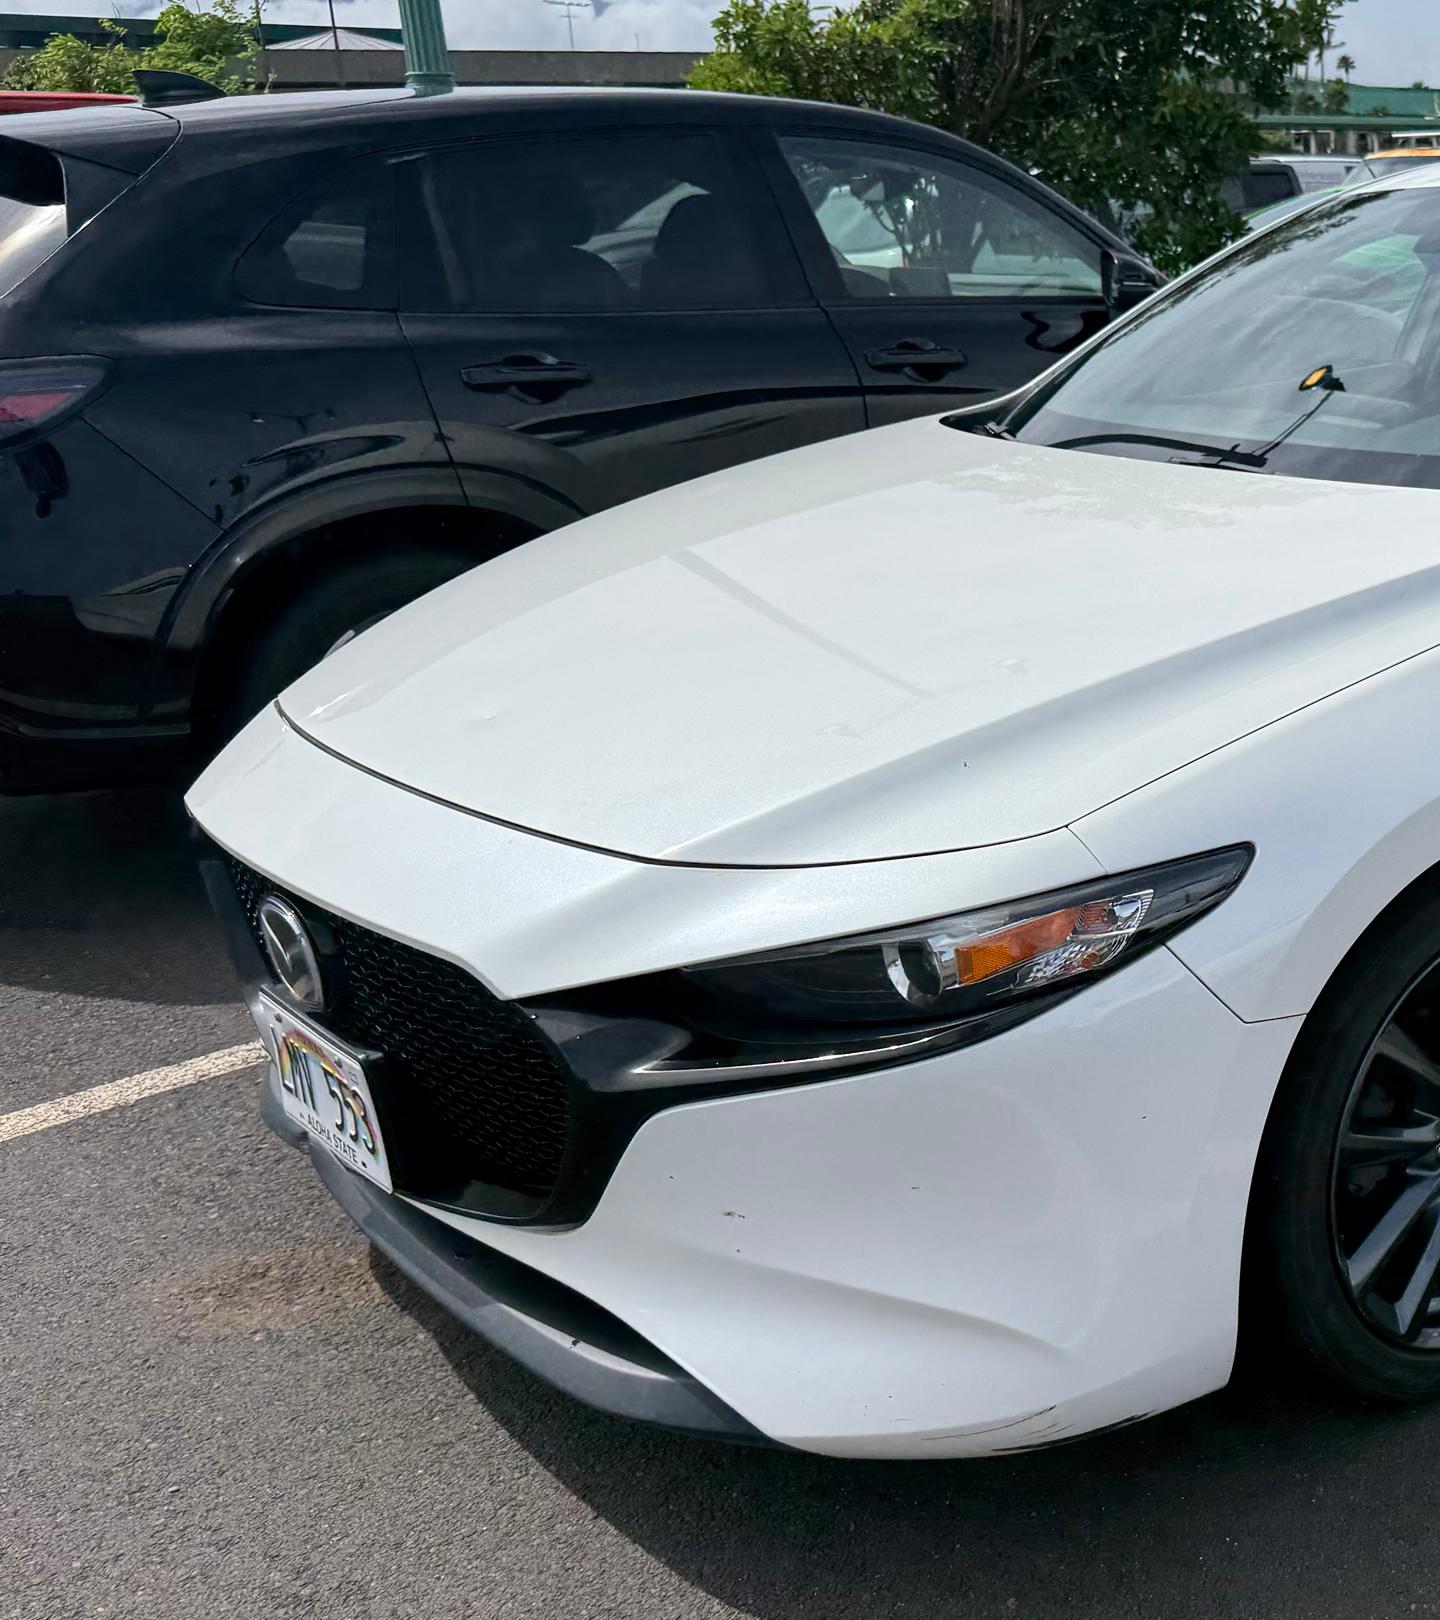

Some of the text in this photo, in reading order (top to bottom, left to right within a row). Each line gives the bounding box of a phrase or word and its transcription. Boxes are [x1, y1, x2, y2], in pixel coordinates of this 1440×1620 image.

[307, 1114, 360, 1164] ALOHA STATE
[320, 1061, 377, 1155] 553
